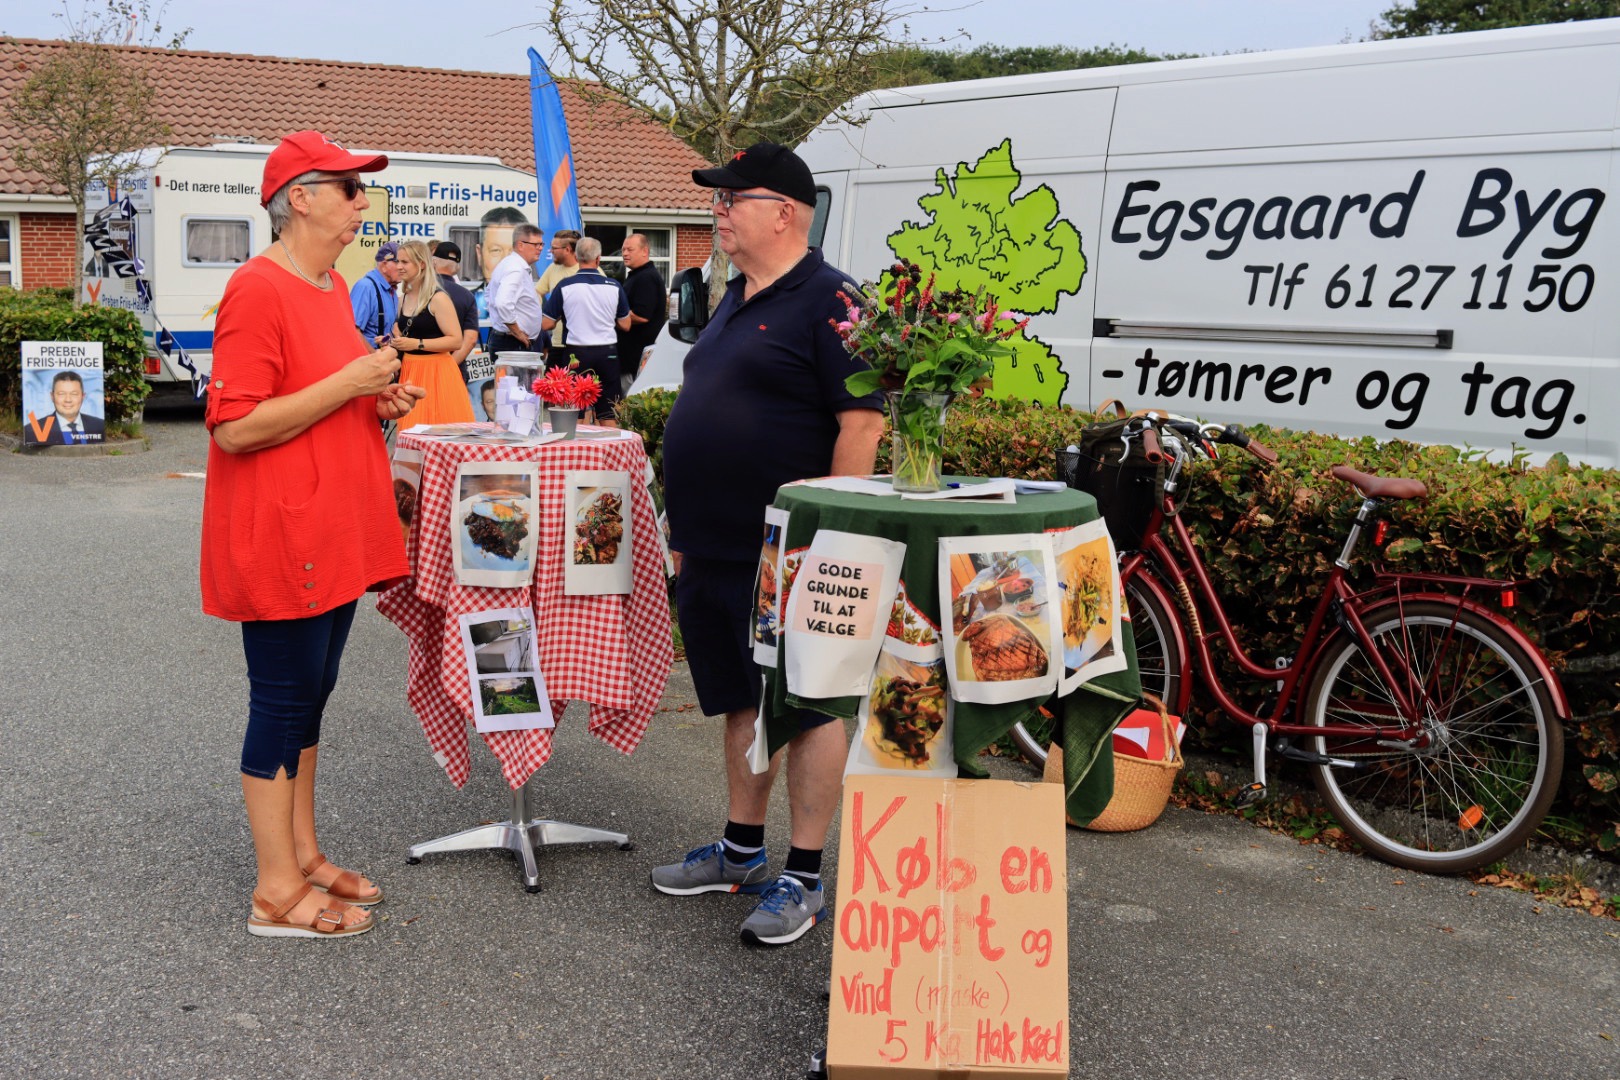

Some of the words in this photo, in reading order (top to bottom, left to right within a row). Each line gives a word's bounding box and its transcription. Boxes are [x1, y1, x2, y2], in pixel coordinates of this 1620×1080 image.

[165, 180, 189, 191] -Det
[192, 183, 220, 193] nære
[429, 182, 537, 207] Friis-Hauge
[423, 203, 468, 216] kandidat
[1111, 169, 1426, 260] Egsgaard
[1456, 167, 1606, 260] Byg
[355, 221, 435, 236] ENSTRE
[360, 238, 375, 247] for
[1243, 262, 1309, 310] Tlf
[1523, 263, 1595, 312] 50
[41, 346, 85, 356] PREBEN
[27, 357, 99, 368] FRIIS-HAUGE
[469, 367, 495, 379] IS-HA
[1356, 369, 1430, 430] og
[1461, 361, 1587, 440] tag.
[818, 562, 862, 580] GODE
[807, 580, 869, 600] GRUNDE
[813, 599, 833, 615] TIL
[837, 604, 856, 617] AT
[806, 618, 856, 636] VÆLGE
[852, 791, 977, 899] Køb
[1000, 846, 1052, 894] en
[1021, 929, 1052, 968] og
[878, 1020, 908, 1063] 5
